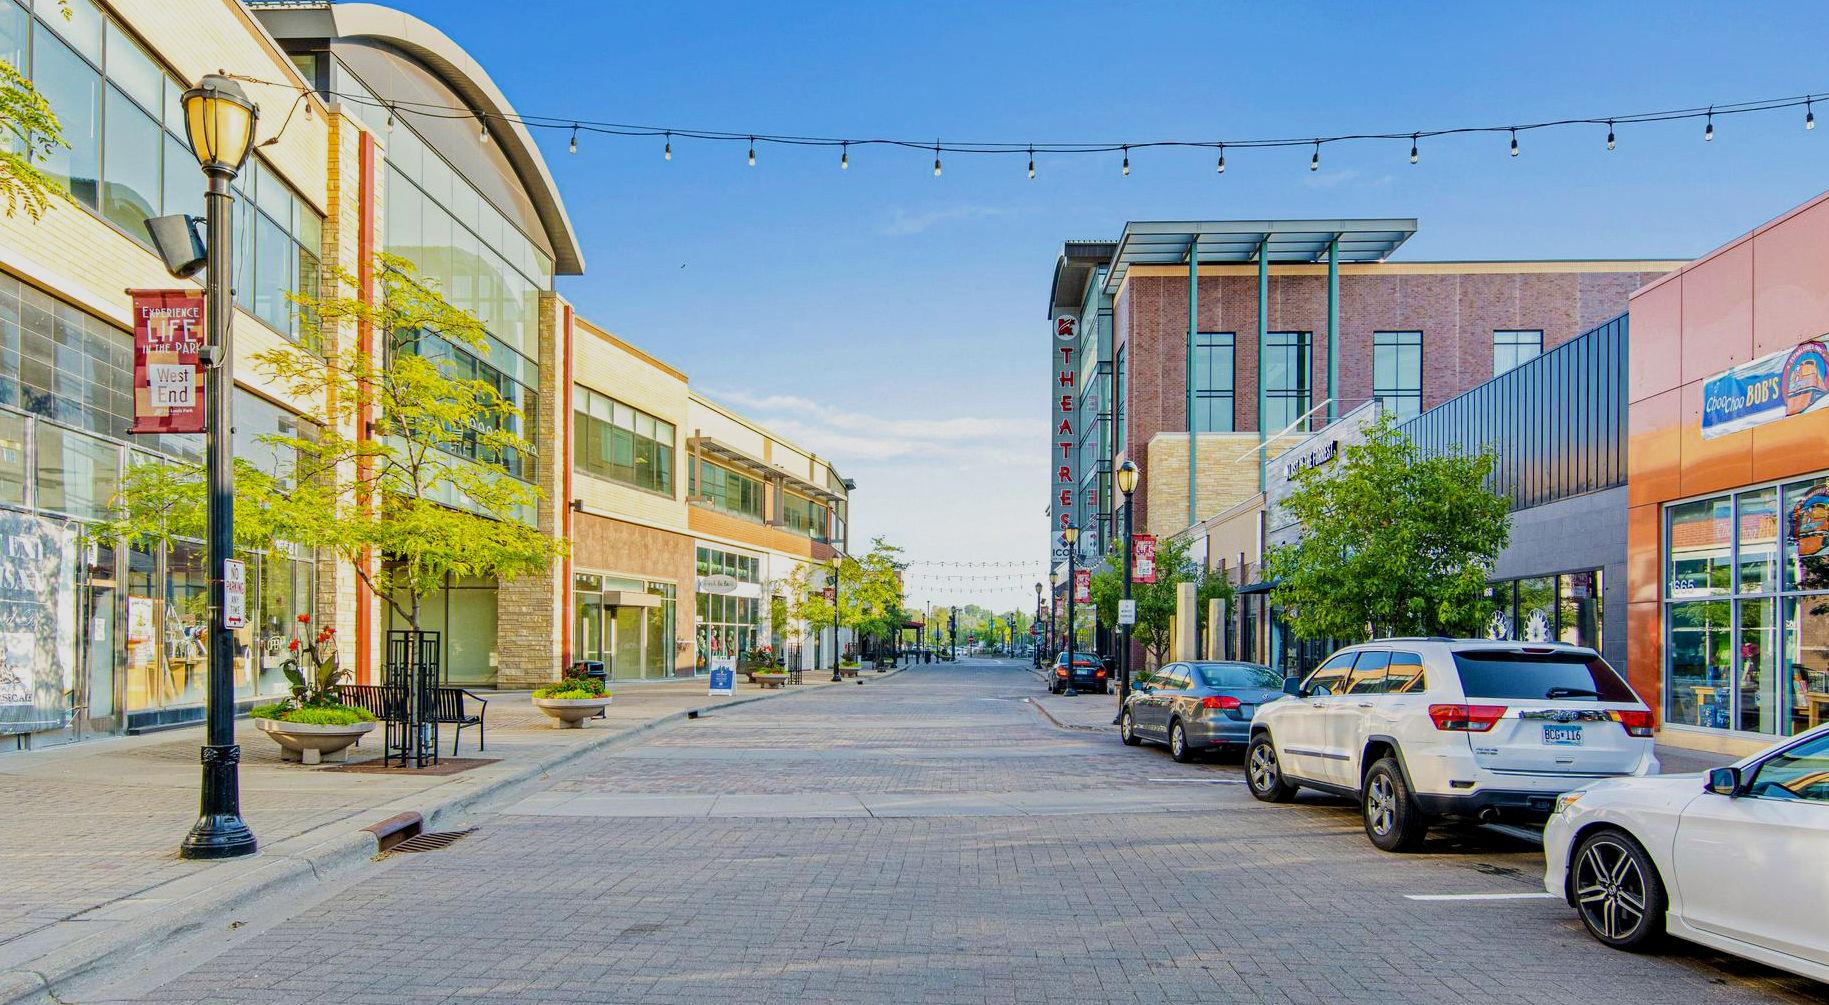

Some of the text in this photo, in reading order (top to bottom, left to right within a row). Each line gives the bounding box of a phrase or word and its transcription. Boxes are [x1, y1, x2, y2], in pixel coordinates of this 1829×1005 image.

[142, 306, 200, 319] EXPERIENCE
[147, 319, 198, 343] LIFE
[142, 341, 201, 355] IN THE PARK
[157, 368, 189, 383] West
[158, 385, 188, 403] End
[1745, 377, 1779, 407] BOB'S
[1059, 346, 1075, 530] THEATRES
[230, 567, 239, 580] NO
[226, 580, 244, 595] PARKING
[231, 595, 240, 604] ANY
[230, 605, 240, 615] TIME
[1545, 729, 1581, 741] BCG 116
